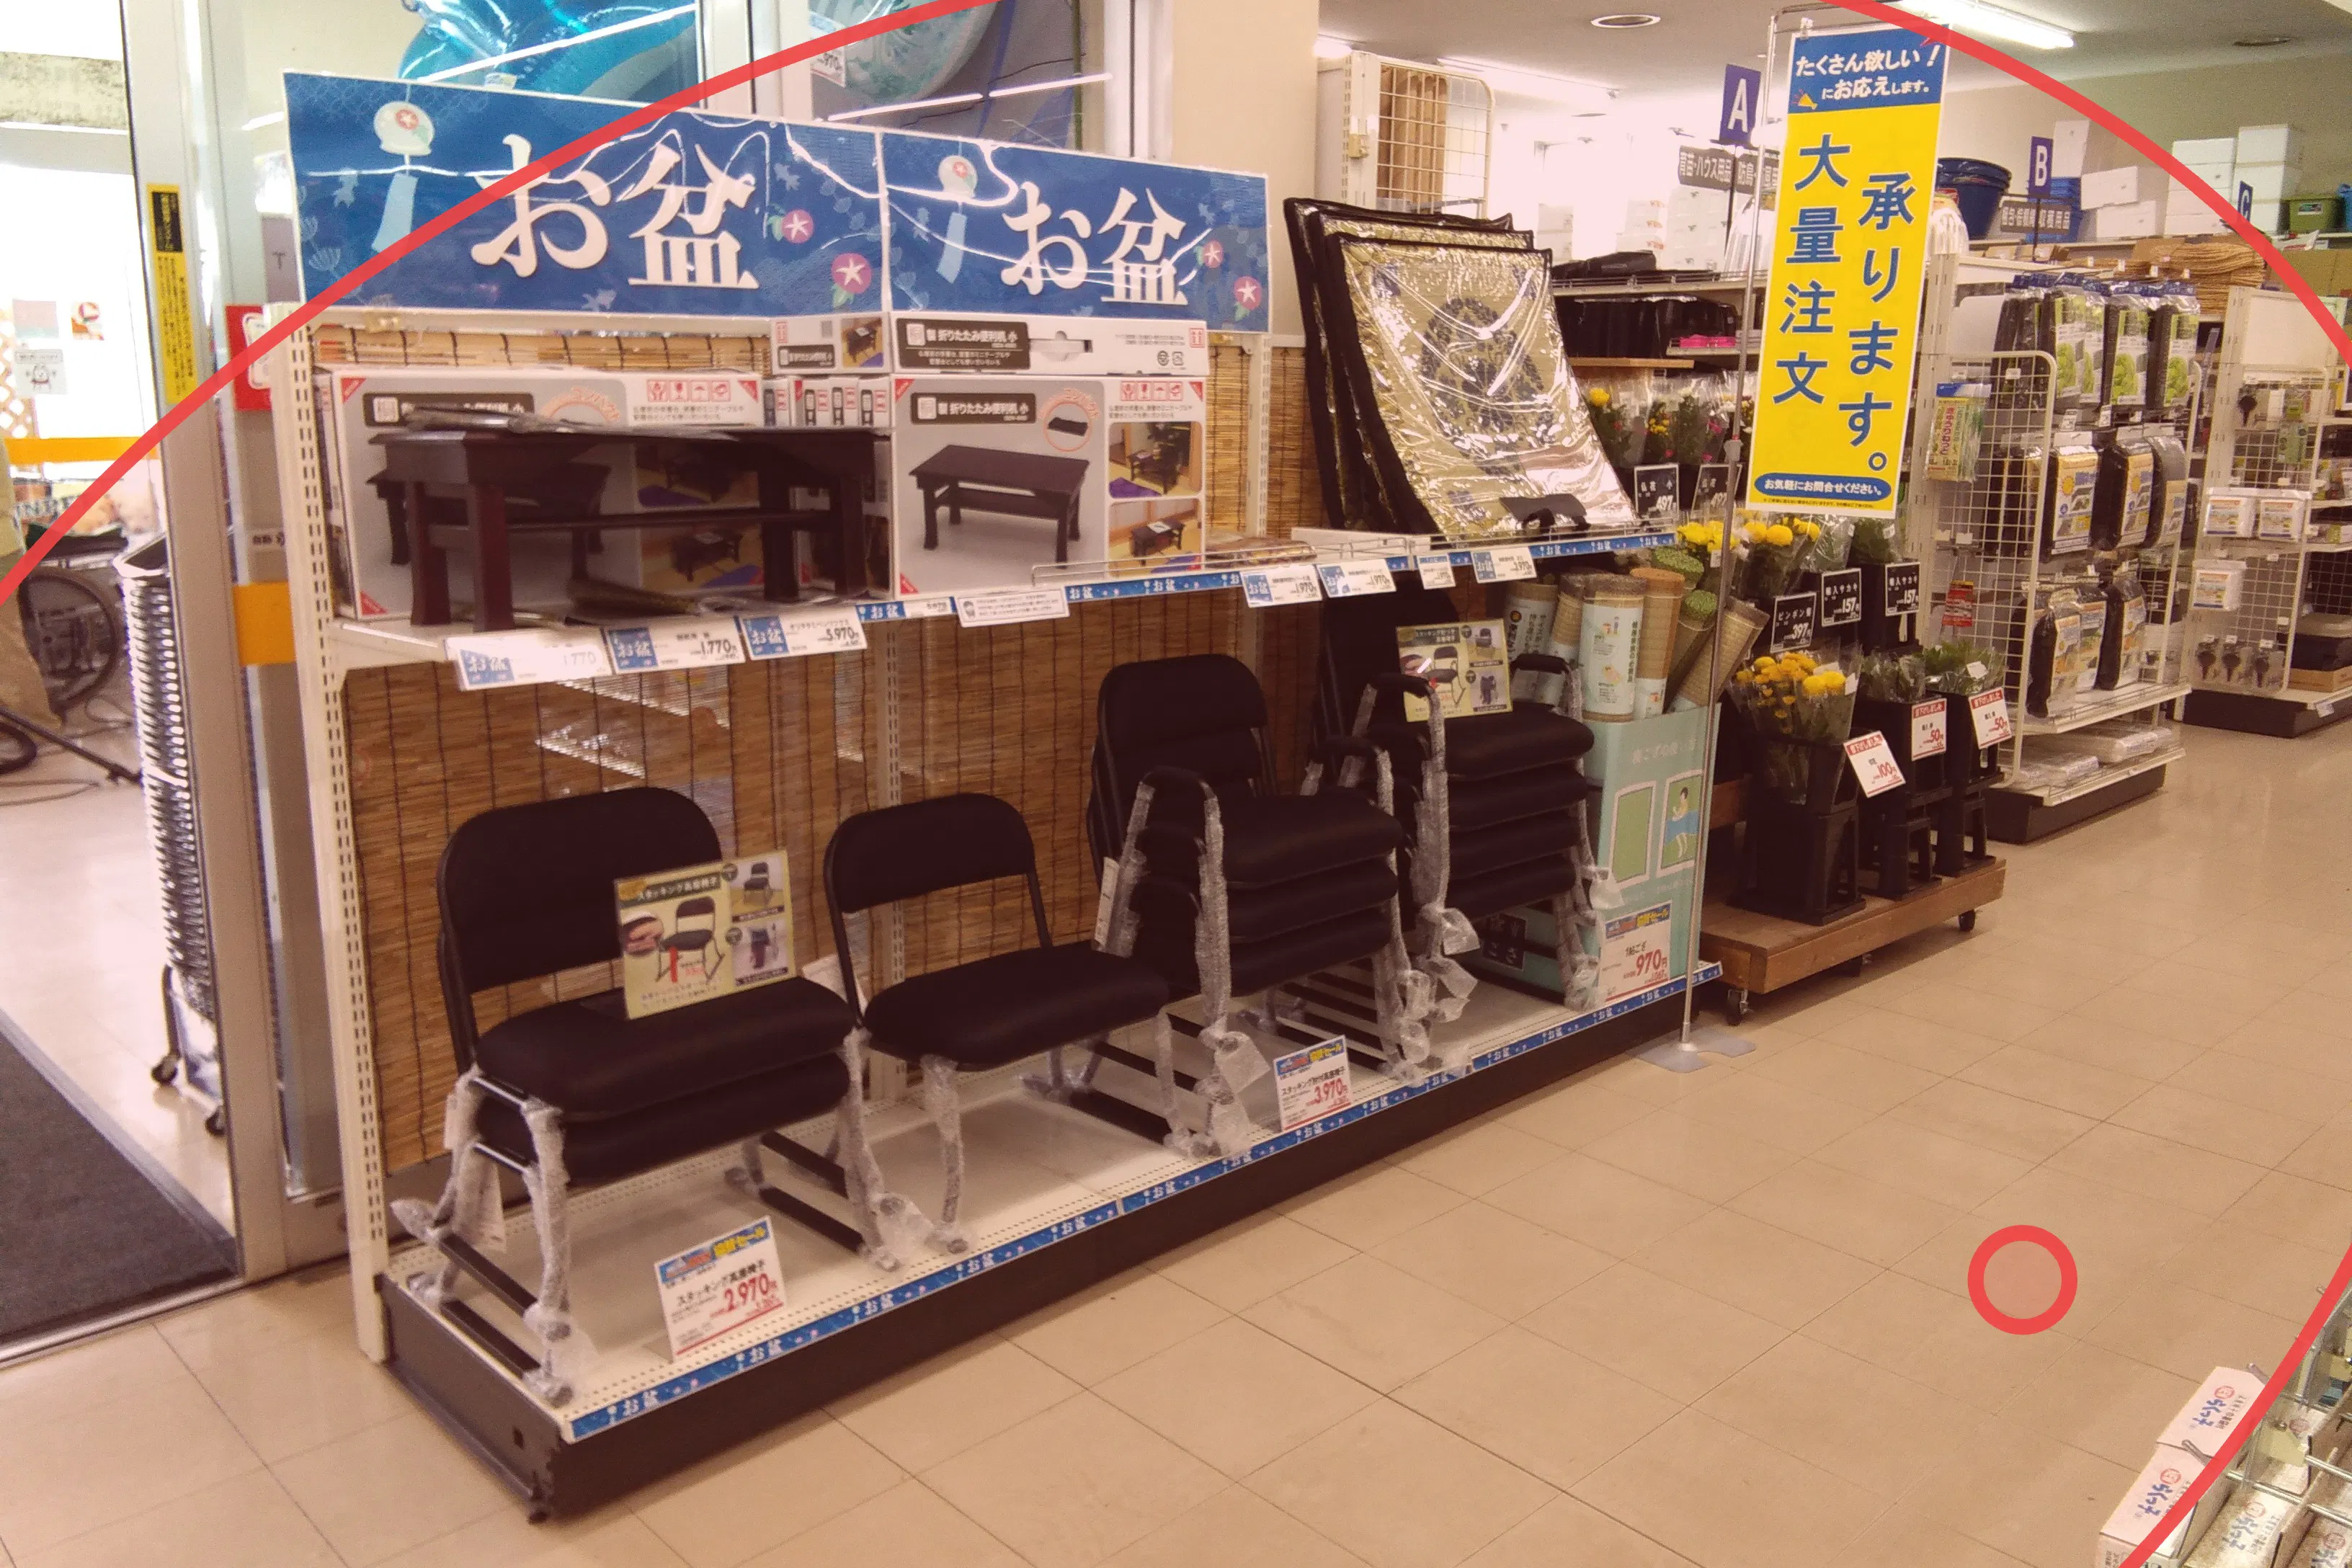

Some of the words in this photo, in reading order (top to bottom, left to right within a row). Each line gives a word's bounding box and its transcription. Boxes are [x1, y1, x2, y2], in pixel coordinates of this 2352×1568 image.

[1727, 78, 1748, 133] A
[1821, 76, 1930, 100] にお応えします。
[2034, 145, 2048, 187] B
[470, 134, 760, 290] お盆
[999, 180, 1188, 306] お盆
[1771, 132, 1851, 405] 大量注文
[1838, 171, 1917, 472] 承ります。
[622, 1389, 659, 1417] お盆
